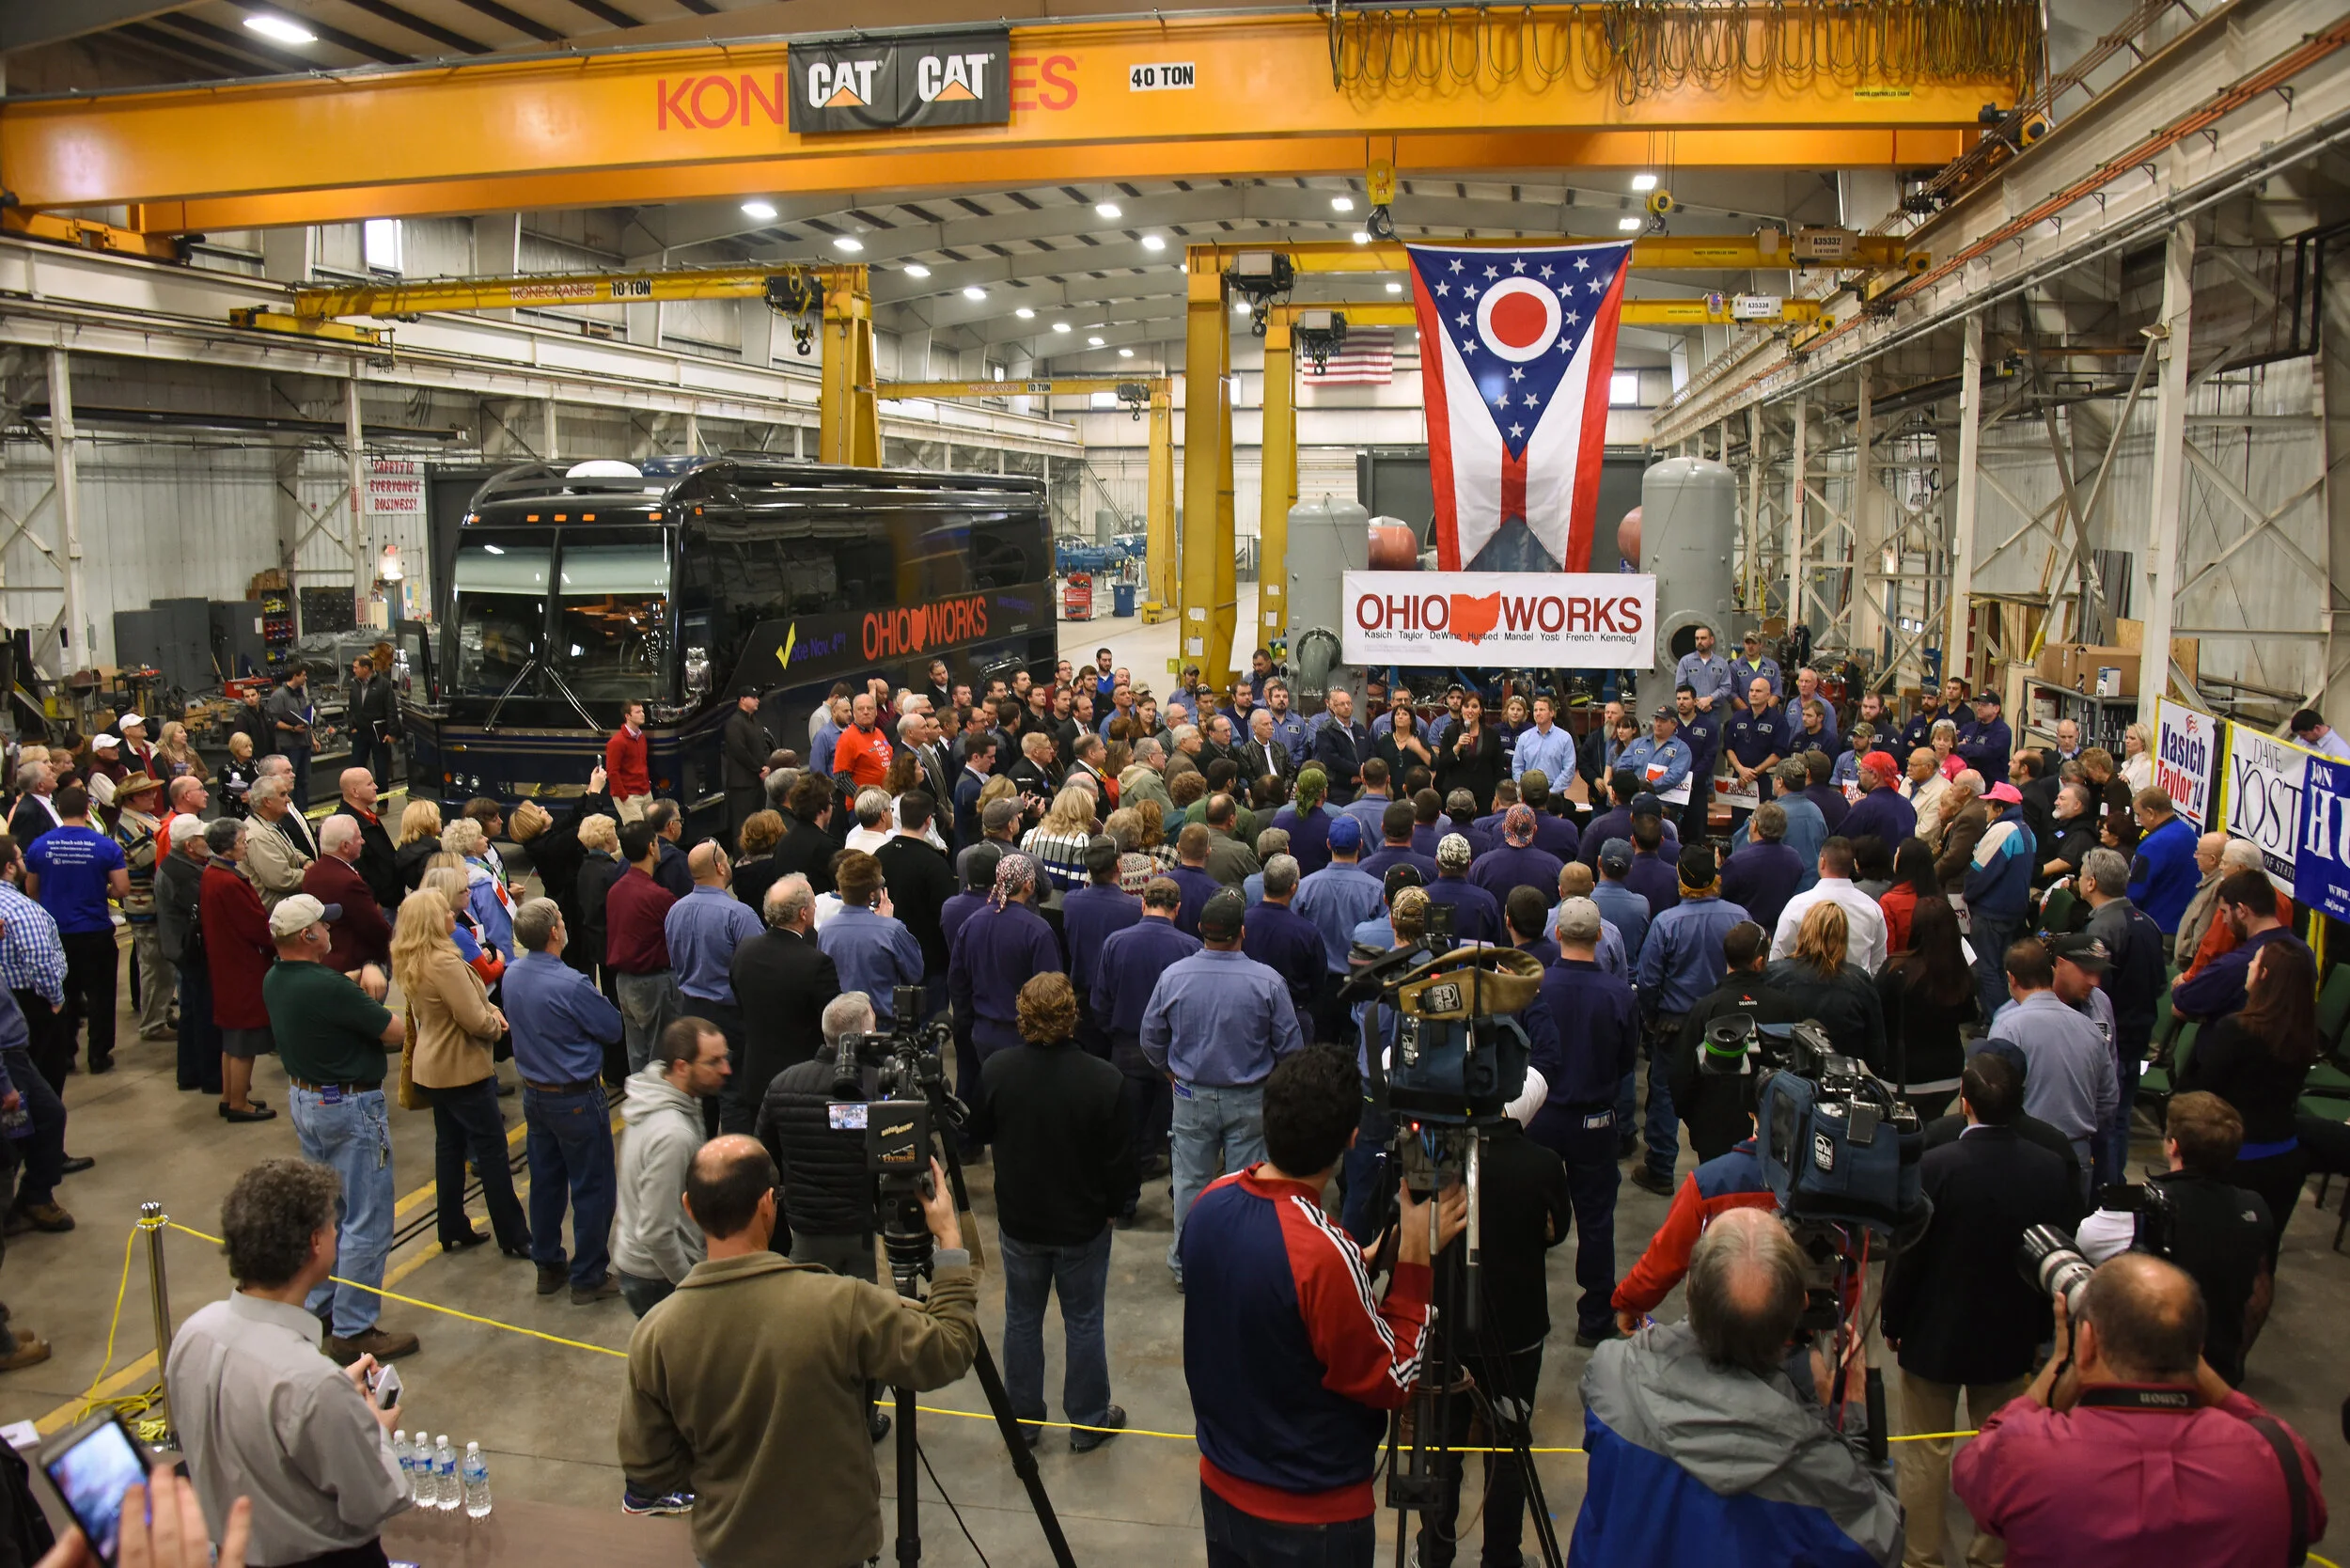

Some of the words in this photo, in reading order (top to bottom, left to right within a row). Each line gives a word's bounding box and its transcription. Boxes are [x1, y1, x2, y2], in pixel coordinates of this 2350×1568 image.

[808, 60, 878, 108] CAT
[918, 54, 990, 102] CAT
[1131, 66, 1157, 87] 40
[1161, 65, 1195, 86] TON
[511, 283, 594, 300] KONECRANES
[612, 282, 625, 296] 10
[629, 280, 650, 296] TON
[1027, 384, 1036, 392] 10
[1038, 383, 1051, 392] TON
[374, 460, 405, 475] SAFETY
[407, 461, 415, 475] IS
[369, 479, 420, 494] EVERYONE'S
[374, 497, 418, 511] BUSINESS!
[1355, 593, 1449, 631] OHIO
[1501, 596, 1642, 634] WORKS
[862, 607, 911, 661] OHIO
[926, 595, 986, 647] WORKS
[1364, 630, 1392, 639] Kasich
[1399, 630, 1423, 642] Taylor
[1429, 631, 1462, 640] DeWine
[1467, 632, 1498, 640] Husted
[1504, 633, 1534, 641] Mandel
[1566, 634, 1594, 642] French
[1600, 634, 1637, 645] Kennedy
[809, 637, 830, 657] Nov.
[2161, 722, 2206, 777] Kasich
[2254, 738, 2283, 774] DAVE
[2311, 761, 2333, 789] JON
[1730, 788, 1758, 798] WORKS
[2157, 759, 2192, 806] Taylor
[2192, 779, 2204, 813] '14
[2231, 753, 2303, 857] YOST
[2264, 855, 2274, 869] OF
[2139, 1392, 2188, 1406] Canon
